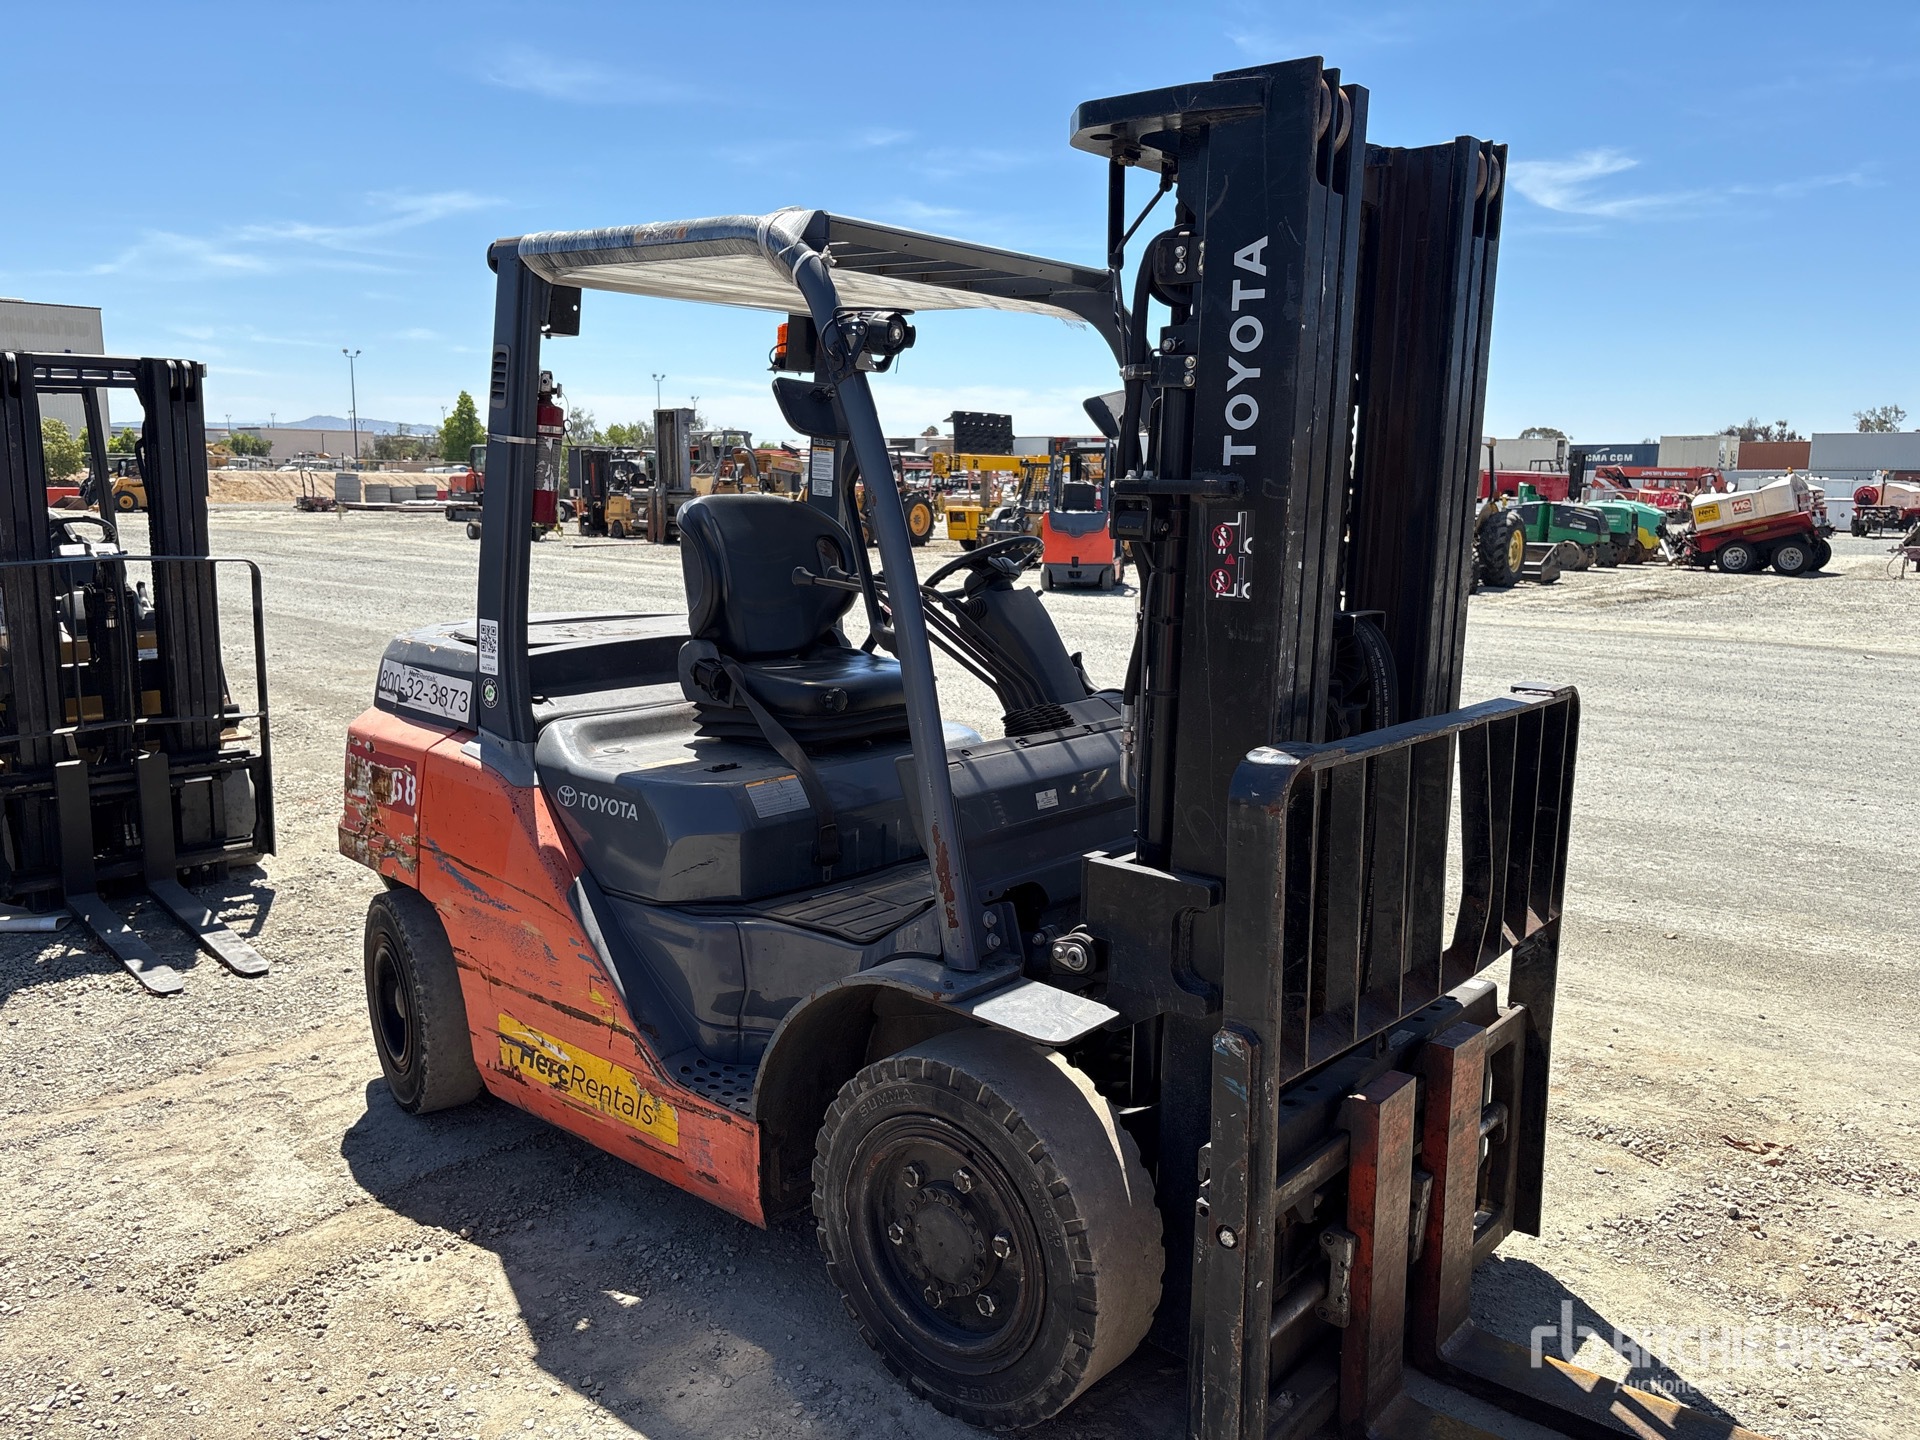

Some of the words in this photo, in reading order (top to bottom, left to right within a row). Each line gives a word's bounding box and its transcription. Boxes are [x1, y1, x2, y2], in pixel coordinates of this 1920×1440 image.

[1222, 235, 1268, 466] TOYOTA
[1585, 453, 1607, 462] CMA
[1609, 453, 1633, 462] CGM
[1698, 508, 1716, 517] Herc
[1733, 501, 1752, 512] MQ
[409, 670, 436, 682] HercRentals
[380, 669, 468, 713] 800-32-3873
[580, 791, 639, 821] TOYOTA
[519, 1047, 658, 1126] HercRentals
[859, 1088, 913, 1117] SUMMA
